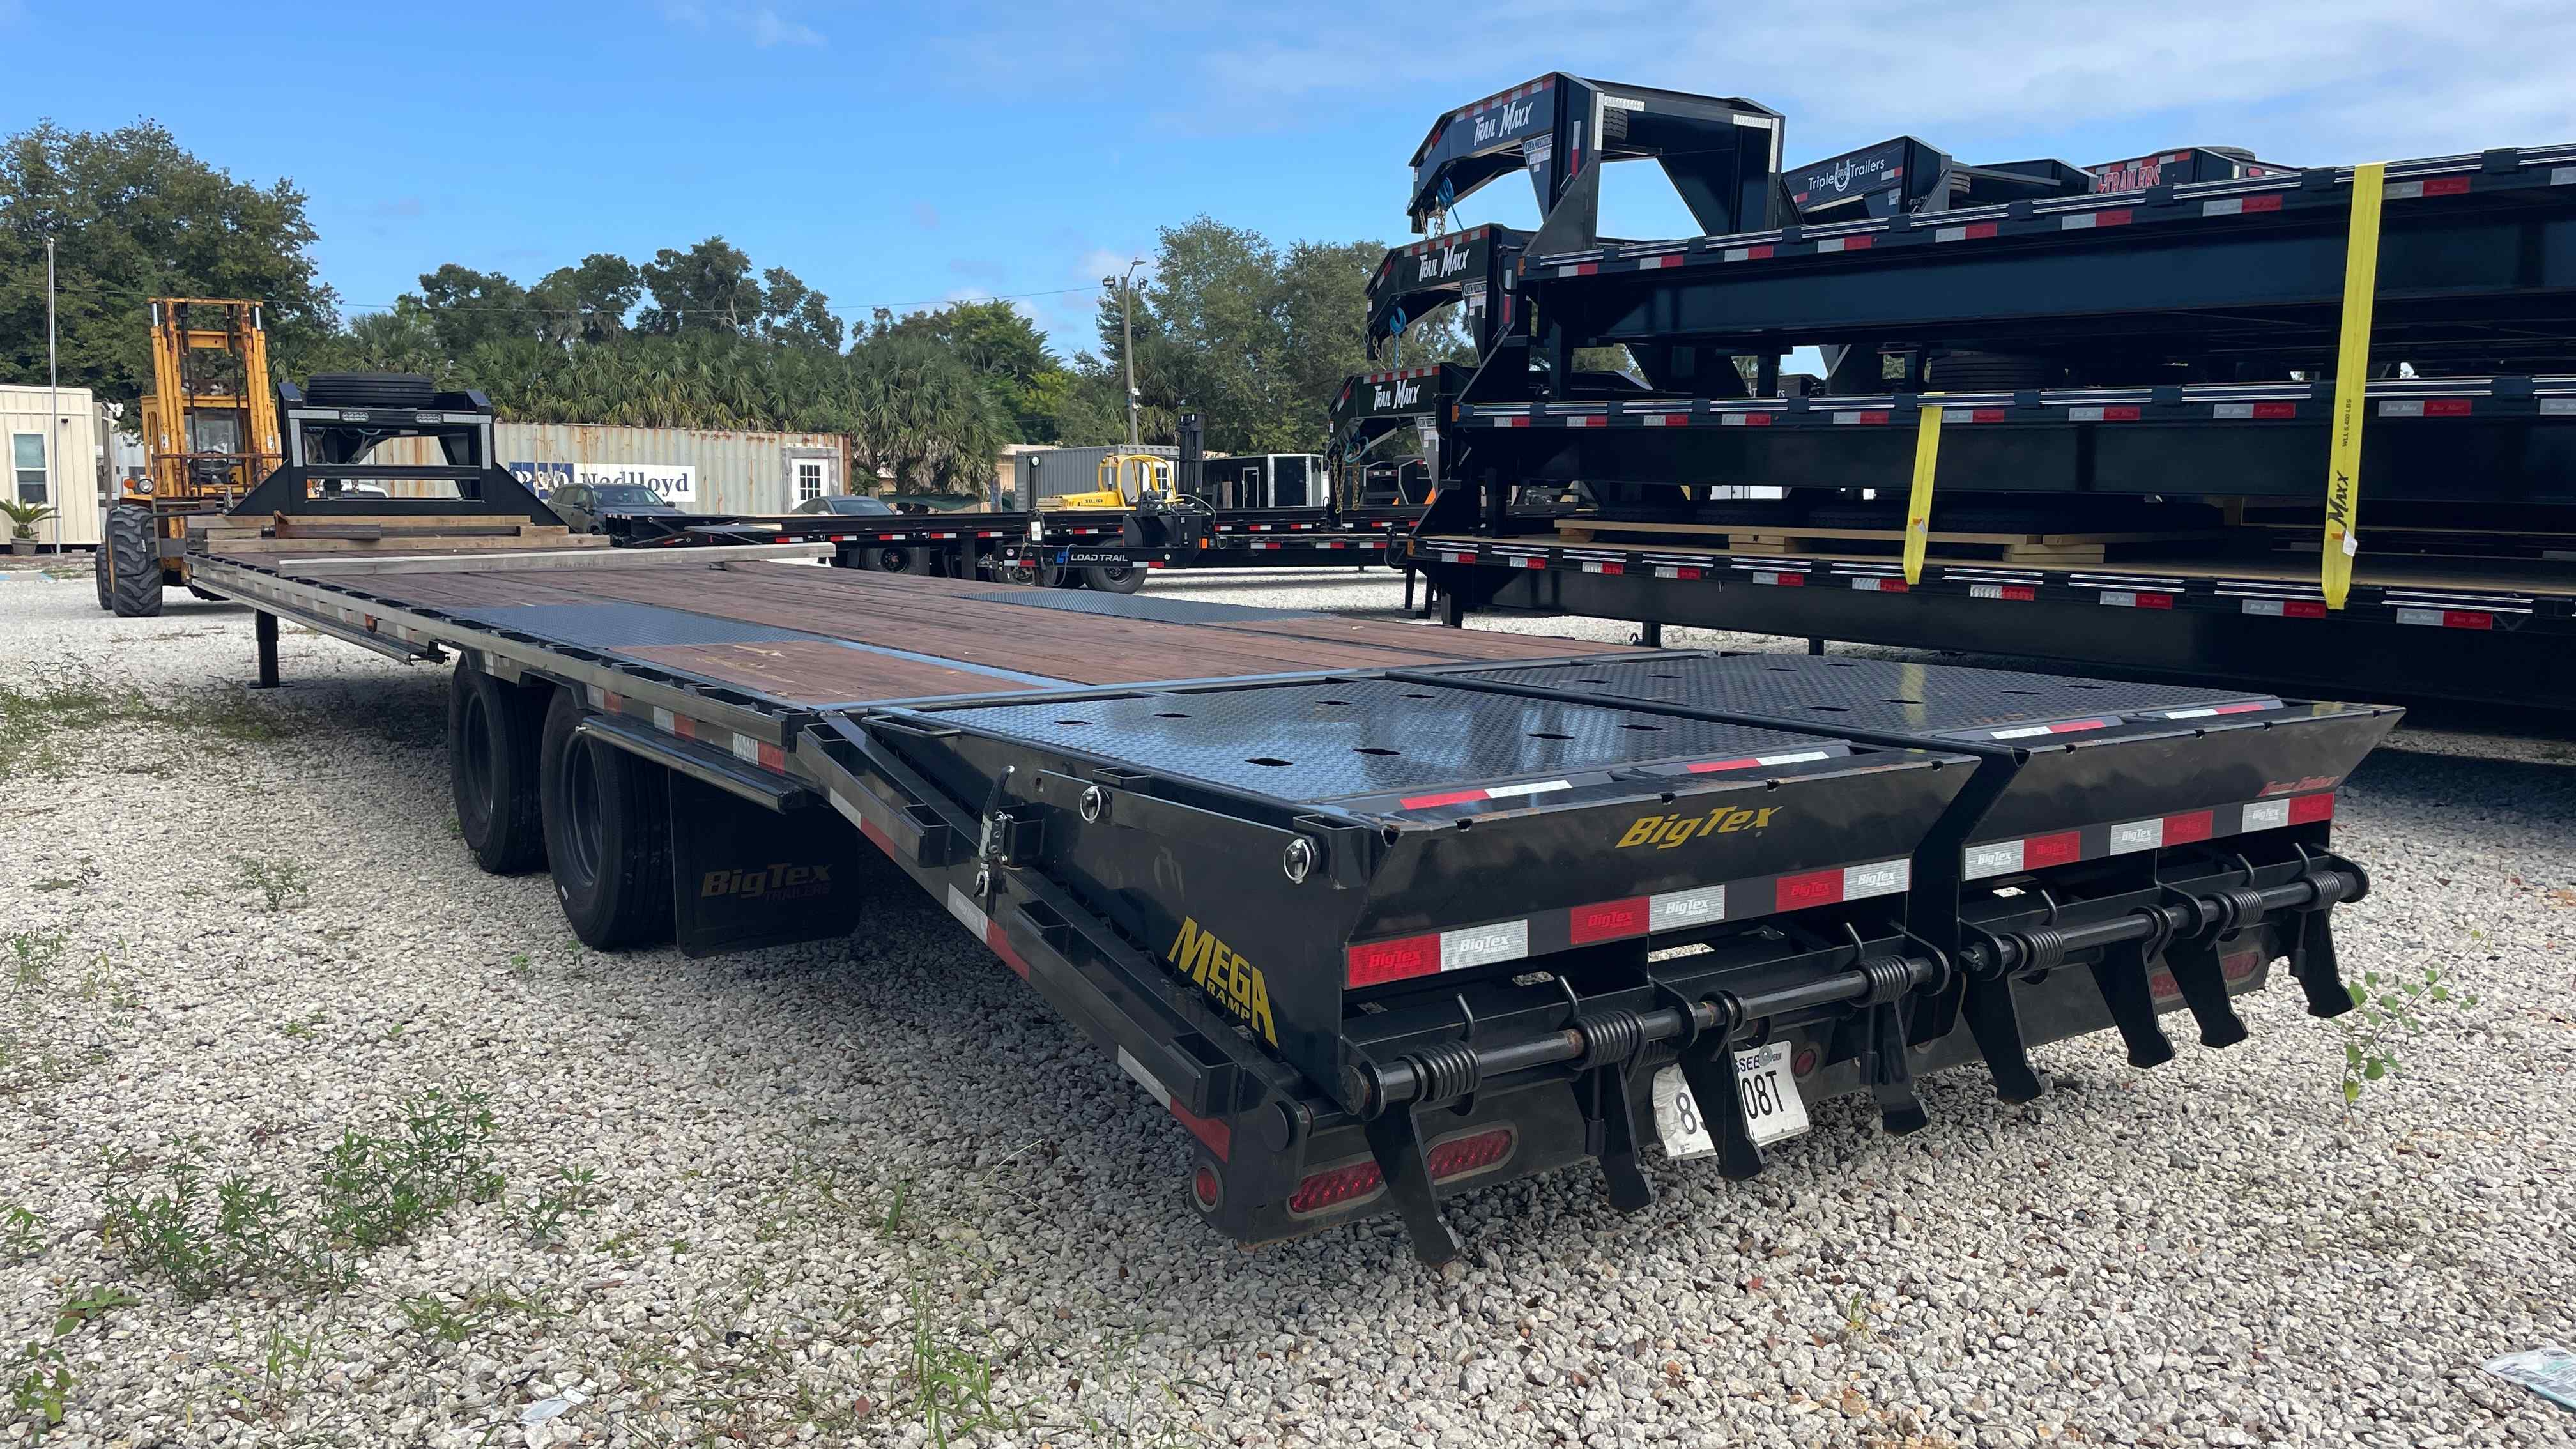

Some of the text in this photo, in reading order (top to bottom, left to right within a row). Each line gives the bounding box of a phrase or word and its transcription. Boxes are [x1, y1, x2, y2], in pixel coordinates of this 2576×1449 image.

[1809, 172, 1834, 191] Triple
[1850, 159, 1885, 178] Trailers
[1100, 554, 1128, 562] TRAIL
[1167, 915, 1279, 1048] MEGA
[1207, 980, 1250, 1020] RAMP
[1742, 1070, 1784, 1119] 08T
